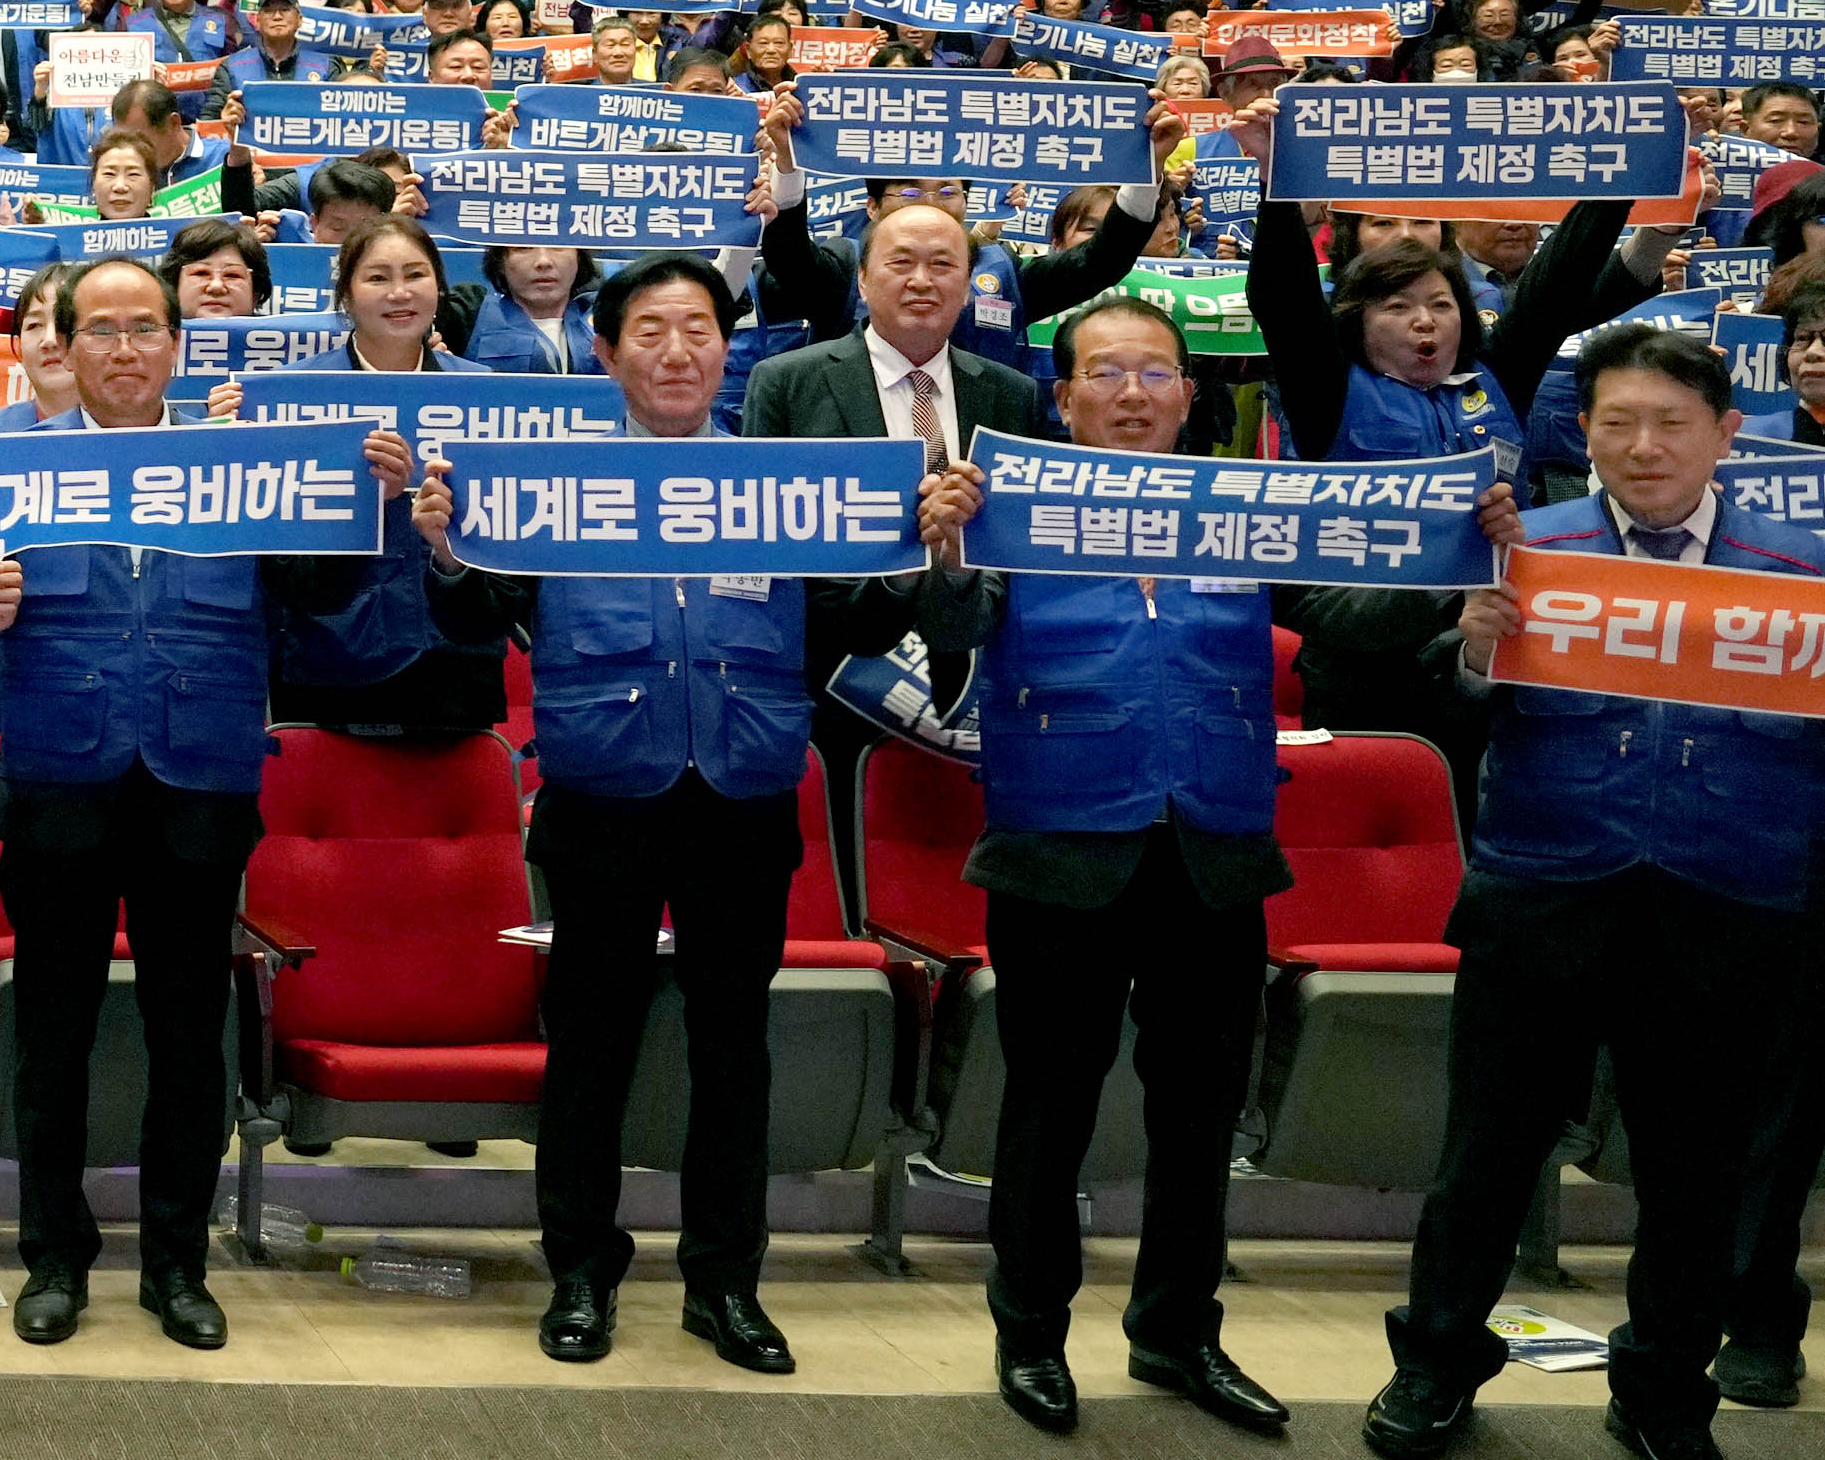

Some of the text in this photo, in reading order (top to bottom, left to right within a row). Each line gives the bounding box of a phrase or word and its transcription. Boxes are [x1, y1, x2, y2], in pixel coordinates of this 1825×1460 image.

[1624, 25, 1726, 49] 전라남도
[1644, 54, 1781, 79] 특별법 제정
[320, 90, 406, 113] 함께하는
[599, 94, 683, 122] 함께하는
[807, 87, 949, 122] 전라남도
[960, 90, 1136, 129] 특별자치도
[1294, 96, 1665, 137] 전라남도 특별자치도
[253, 116, 472, 149] 바르게살기운동!
[836, 129, 943, 165] 특별법
[953, 132, 1103, 171] 제정 촉구
[433, 160, 744, 200] 전라남도 특별자치도
[1326, 143, 1627, 184] 특별법 제정 촉구
[458, 200, 715, 238] 특별법 제정 촉구
[130, 459, 355, 525] 웅비하는
[990, 452, 1476, 511] 전라남도 특별자치도
[461, 477, 903, 542] 세계로 웅비하는
[1029, 505, 1422, 567] 특별법 제정 촉구
[1525, 590, 1687, 664] 우리
